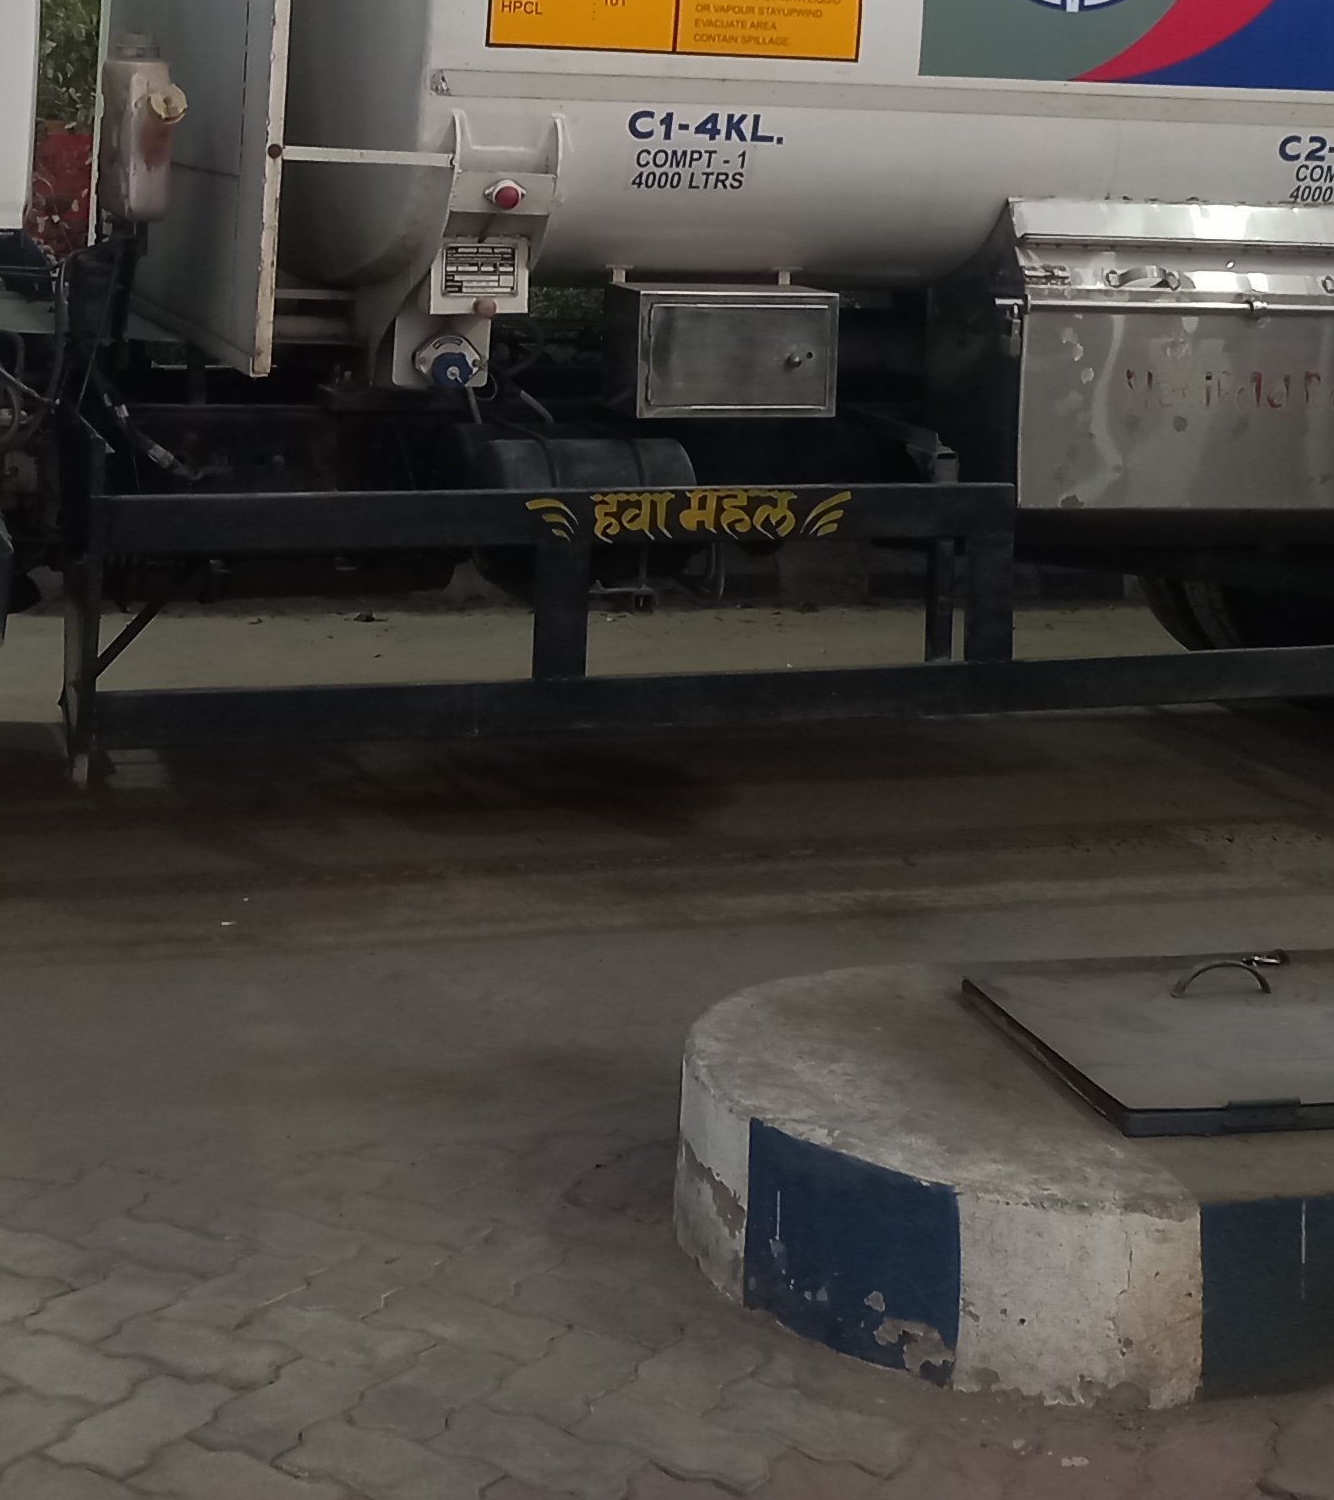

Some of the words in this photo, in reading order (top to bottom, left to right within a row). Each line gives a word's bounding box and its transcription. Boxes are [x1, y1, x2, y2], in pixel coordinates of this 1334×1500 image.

[501, 0, 543, 16] HPCL
[713, 4, 755, 15] VAPOUR
[694, 18, 747, 30] EVACUATE
[749, 21, 777, 31] AREA
[693, 33, 738, 45] CONTAIN
[741, 35, 789, 47] SPILLAGE
[628, 110, 784, 145] C1-4KL.
[636, 149, 717, 169] COMPT
[631, 171, 682, 190] 4000
[688, 171, 744, 190] LTRS
[1289, 185, 1333, 204] 4000
[589, 491, 676, 544] हवा
[679, 489, 798, 540] महल
